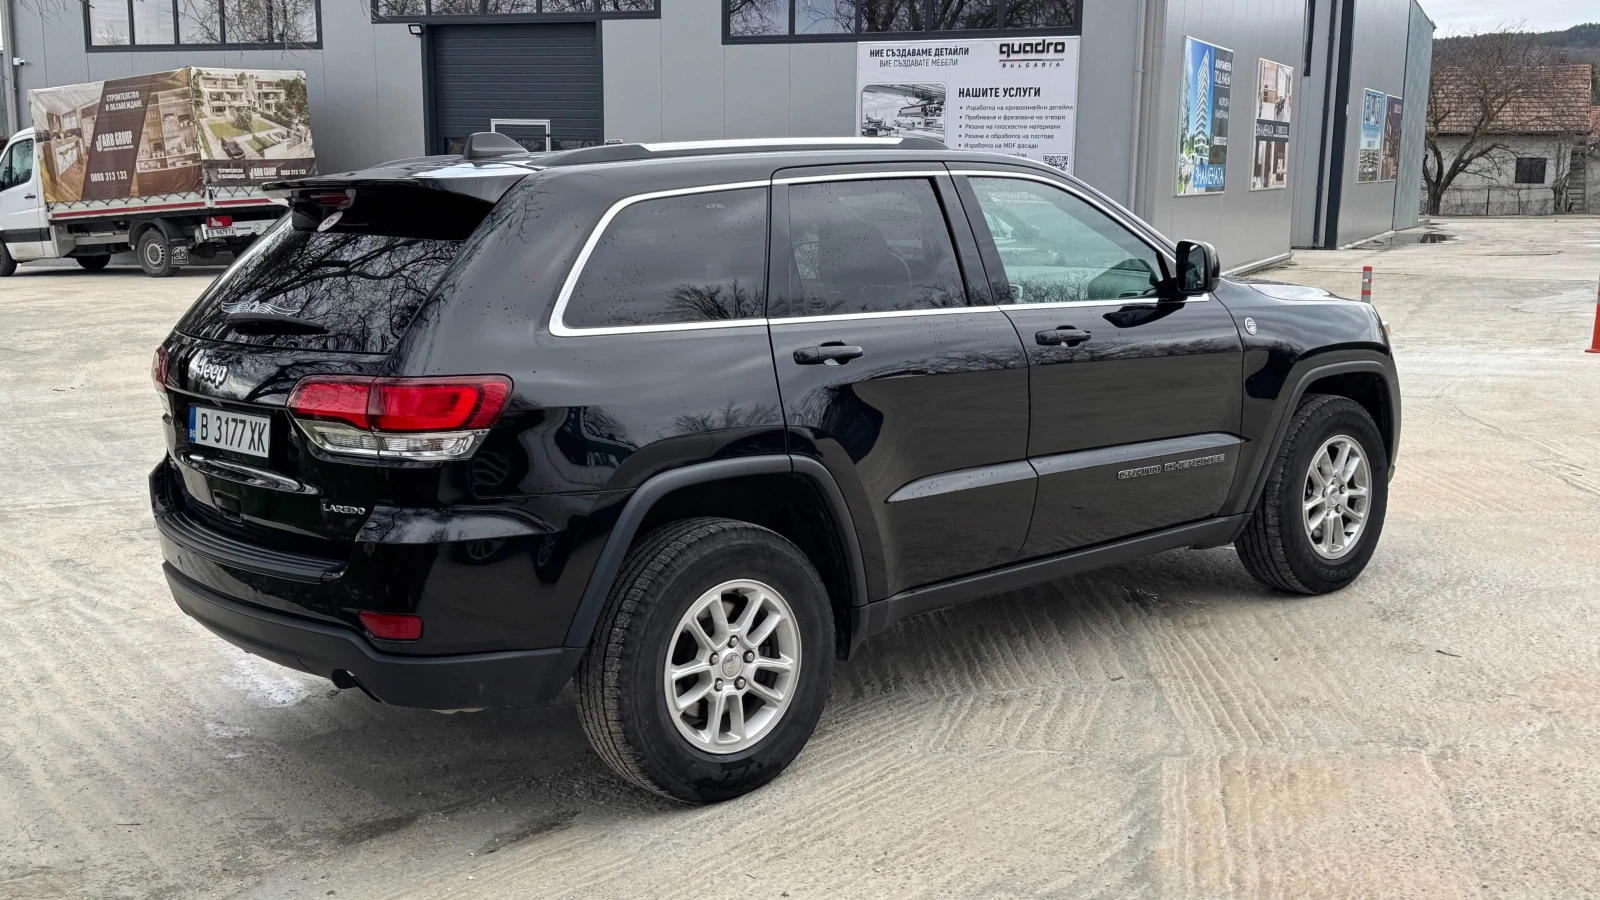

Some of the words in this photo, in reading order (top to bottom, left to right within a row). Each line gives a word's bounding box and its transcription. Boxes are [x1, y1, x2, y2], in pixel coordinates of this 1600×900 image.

[869, 49, 885, 58] НИЕ
[885, 48, 933, 58] СЪЗДАВАМЕ
[934, 46, 970, 58] ДЕТАЙЛИ
[999, 39, 1066, 58] quadro
[879, 60, 893, 68] ВИЕ
[893, 58, 930, 68] СЪЗДАВАТЕ
[931, 58, 959, 67] МЕБЕЛИ
[106, 91, 140, 102] СТРОИТЕЛСТВО
[958, 88, 1000, 98] НАШИТЕ
[1002, 87, 1041, 98] УСЛУГИ
[105, 104, 109, 112] И
[110, 100, 142, 111] ОБЗАВЕЖДАНЕ
[966, 104, 996, 112] Изработка
[102, 133, 115, 147] ARB
[115, 130, 133, 145] GROUP
[105, 172, 116, 181] 313
[117, 170, 127, 180] 133
[197, 357, 228, 388] Jeep
[201, 413, 209, 440] B
[214, 416, 247, 448] 3177
[248, 420, 267, 453] XK
[1117, 465, 1162, 480] GRAND
[1164, 454, 1225, 471] CHEROKEE
[322, 503, 366, 515] LAREDO
